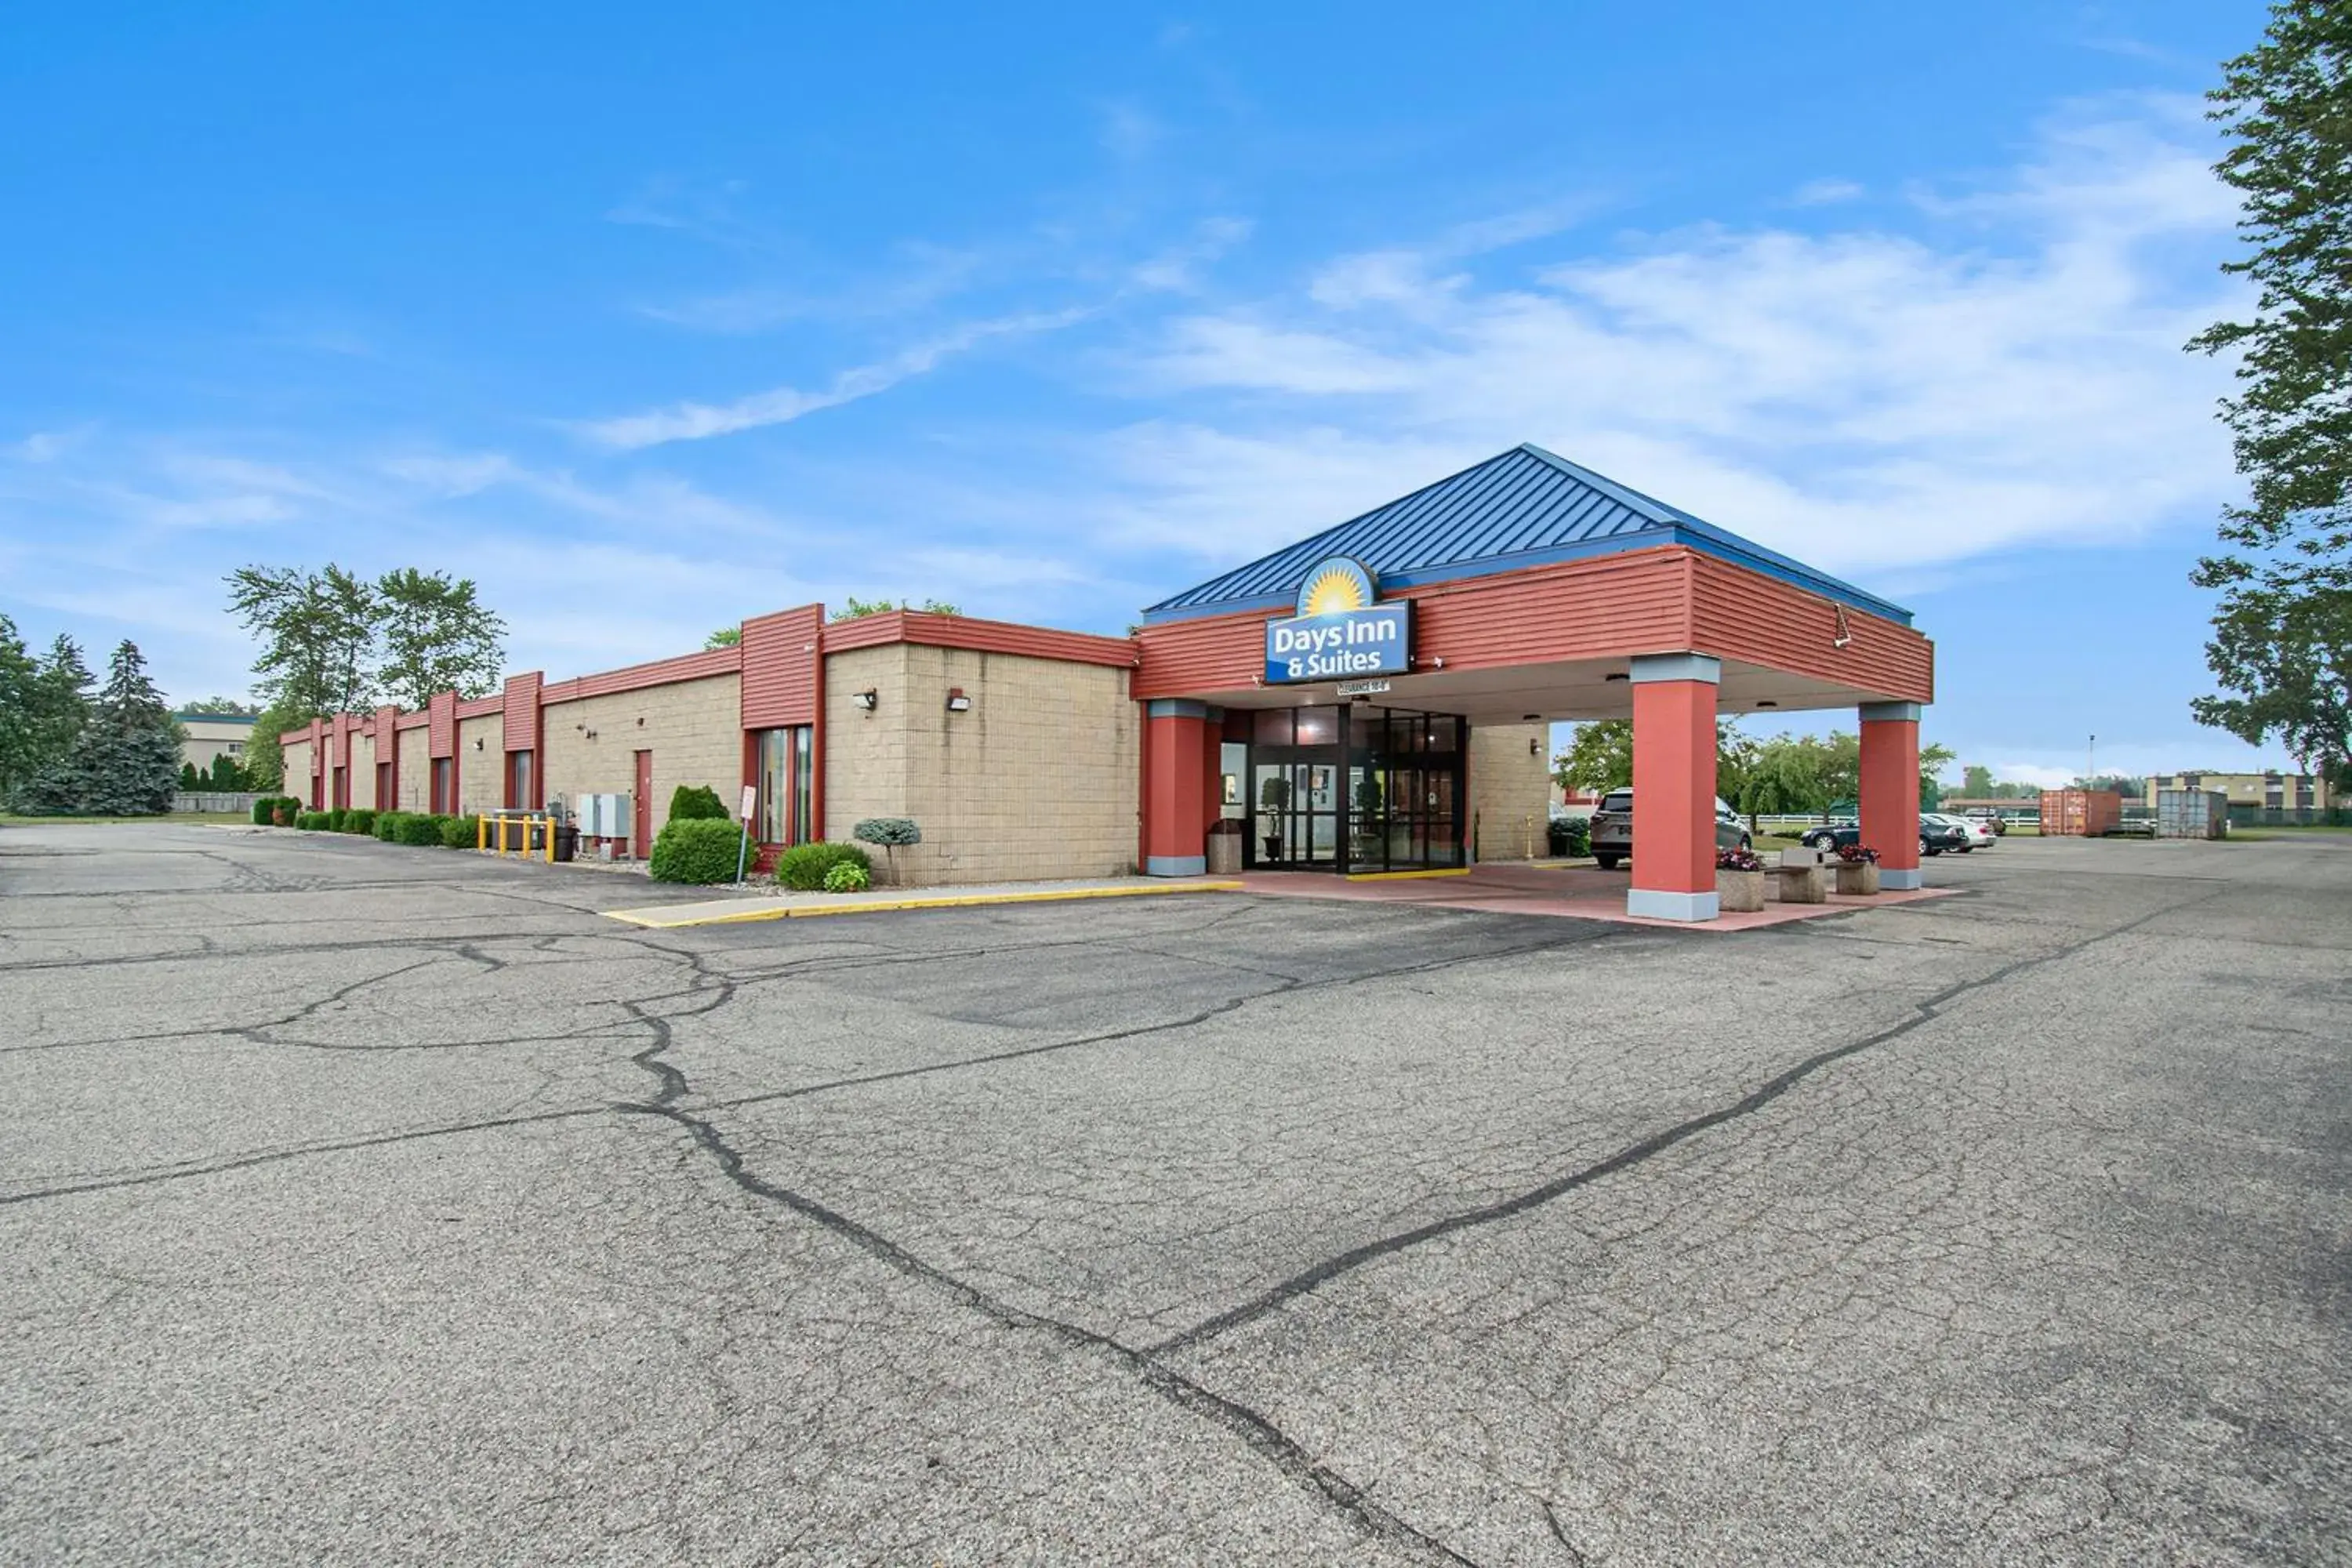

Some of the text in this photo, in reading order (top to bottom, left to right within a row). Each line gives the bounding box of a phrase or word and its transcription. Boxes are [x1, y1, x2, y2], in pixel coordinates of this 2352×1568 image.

[1274, 619, 1396, 653] Days Inn
[1287, 649, 1381, 677] & Suites
